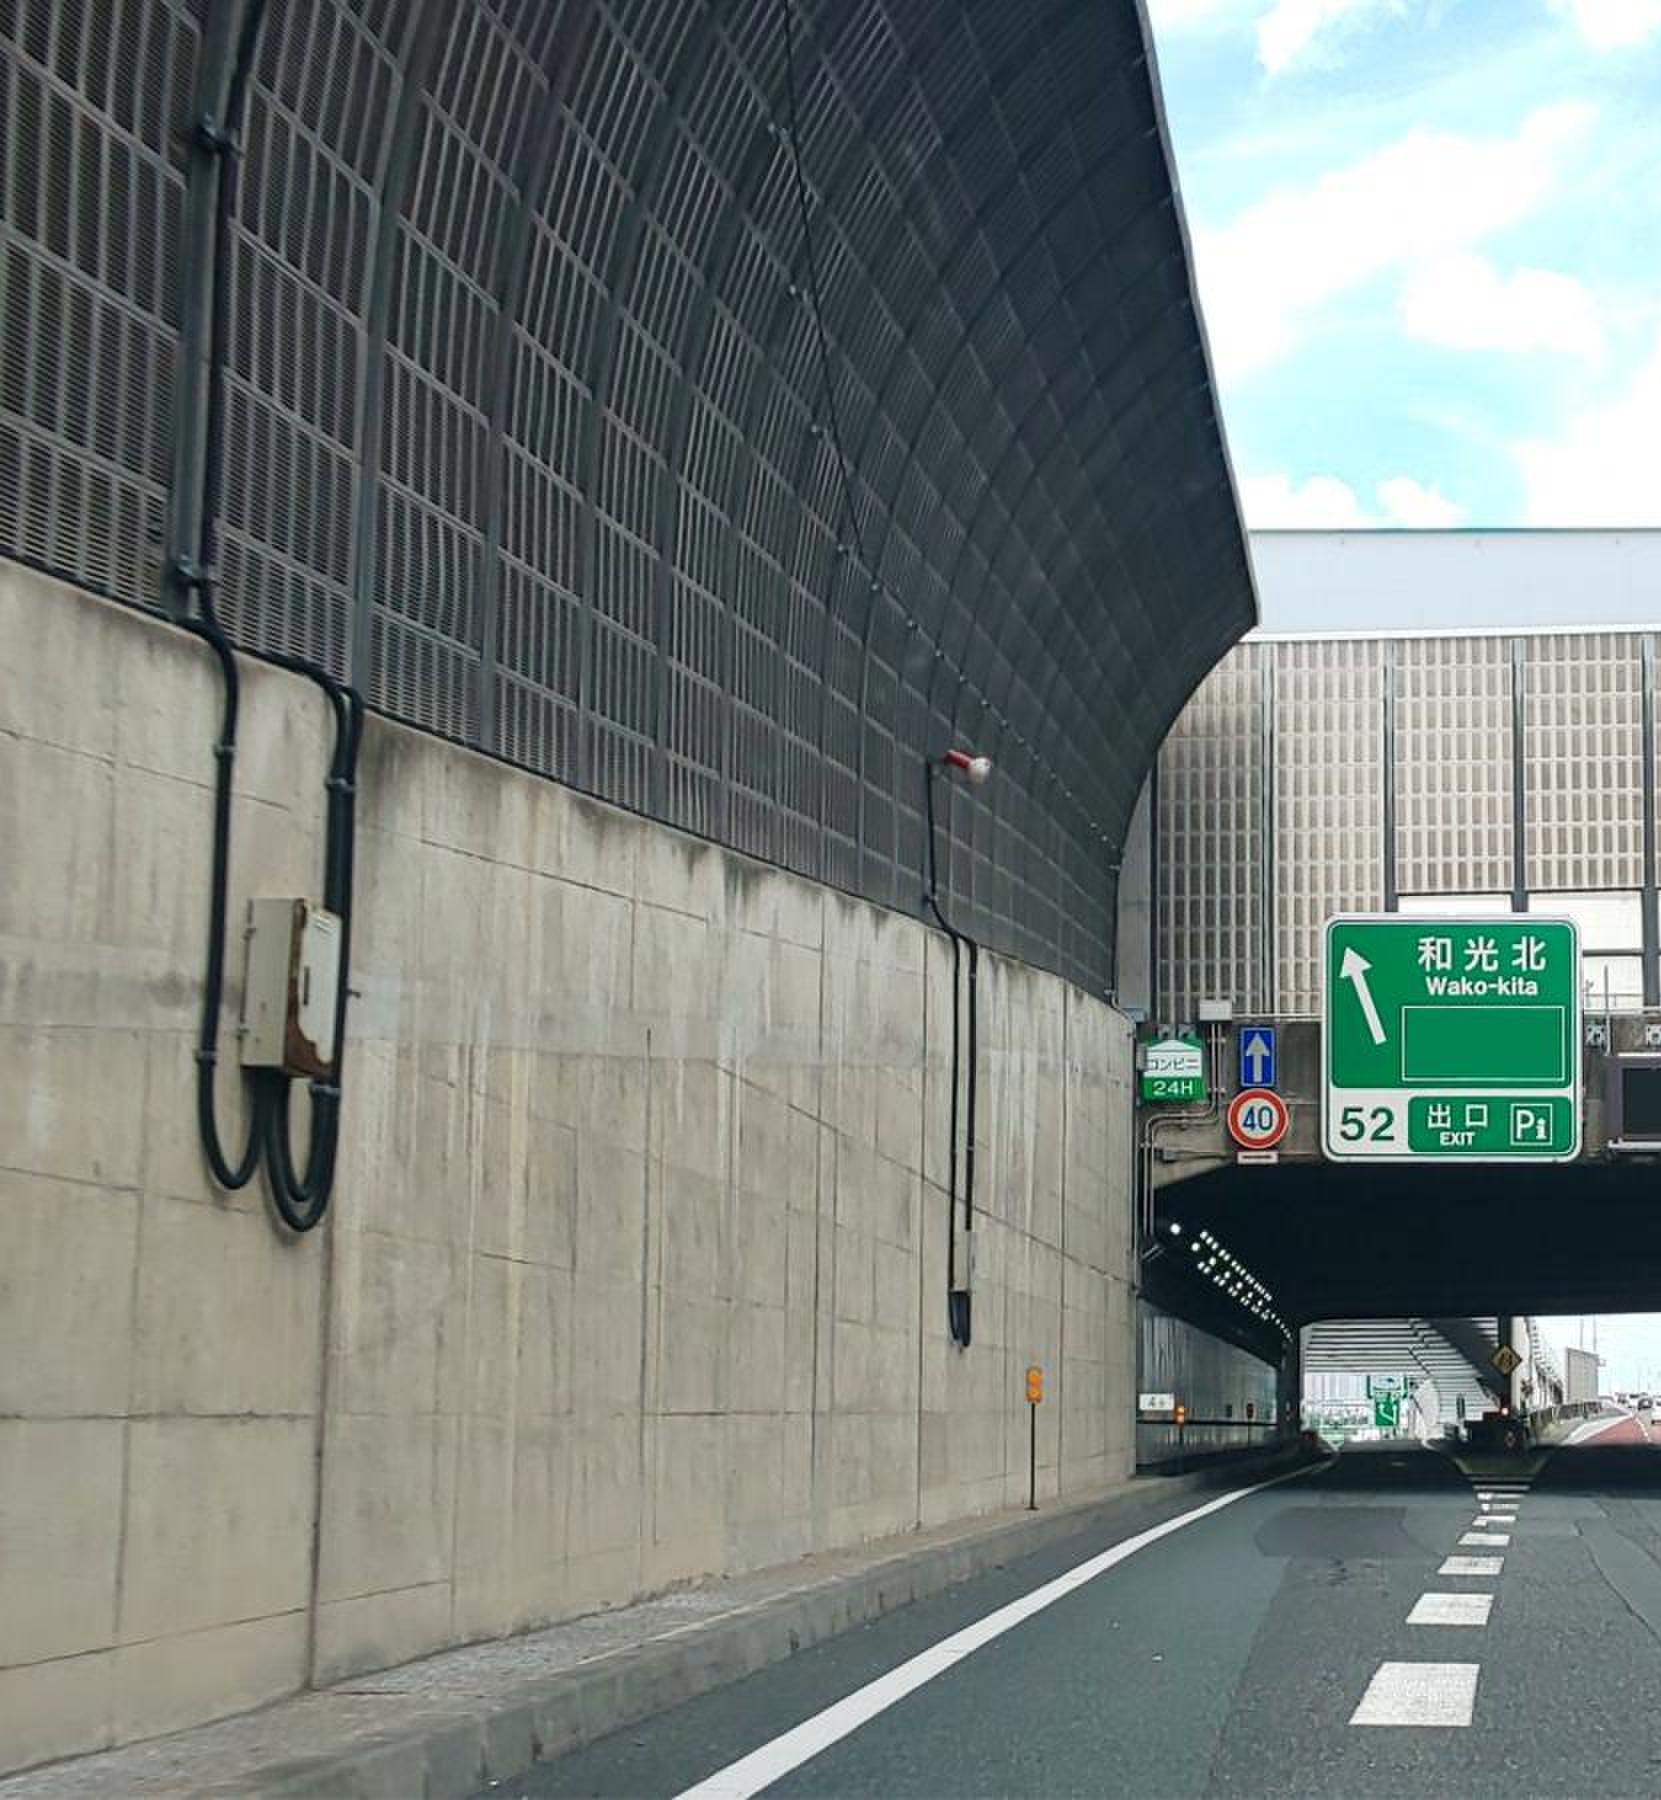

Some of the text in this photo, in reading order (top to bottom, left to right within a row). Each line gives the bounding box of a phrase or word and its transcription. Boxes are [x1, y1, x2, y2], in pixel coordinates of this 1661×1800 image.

[1417, 935, 1547, 972] 和光北
[1425, 976, 1539, 996] Wako-kita
[1148, 1057, 1199, 1071] コンビニ
[1152, 1080, 1194, 1096] 24H
[1242, 1105, 1273, 1131] 40
[1339, 1106, 1395, 1142] 52
[1427, 1103, 1488, 1129] 出口
[1439, 1131, 1476, 1146] EXIT
